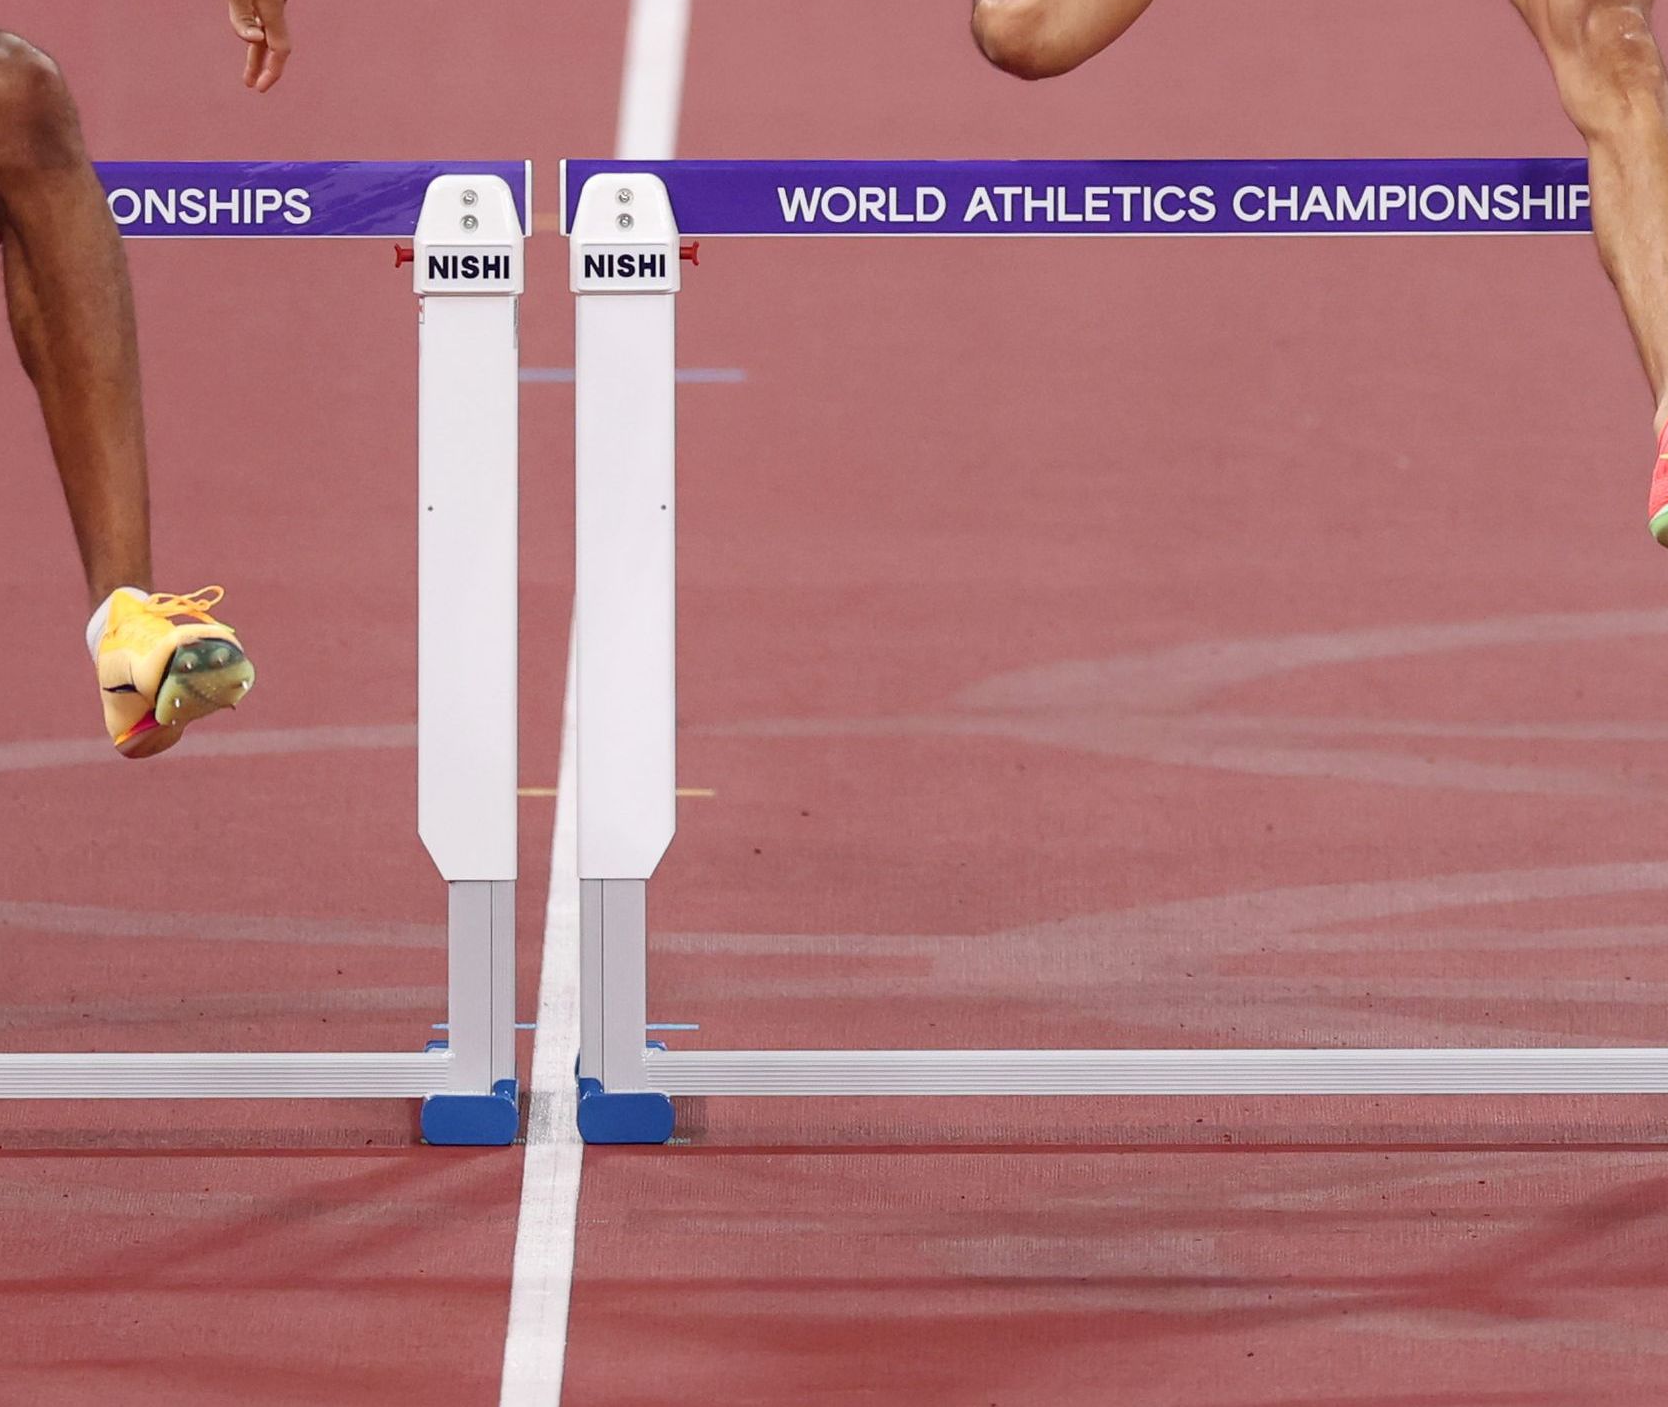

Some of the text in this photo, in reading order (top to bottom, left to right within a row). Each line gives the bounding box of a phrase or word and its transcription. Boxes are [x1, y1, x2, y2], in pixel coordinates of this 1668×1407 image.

[106, 187, 313, 225] ONSHIPS
[777, 184, 1591, 223] WORLD ATHLETICS CHAMPIONSHIP
[428, 255, 510, 280] NISHI
[584, 253, 666, 278] NISHI
